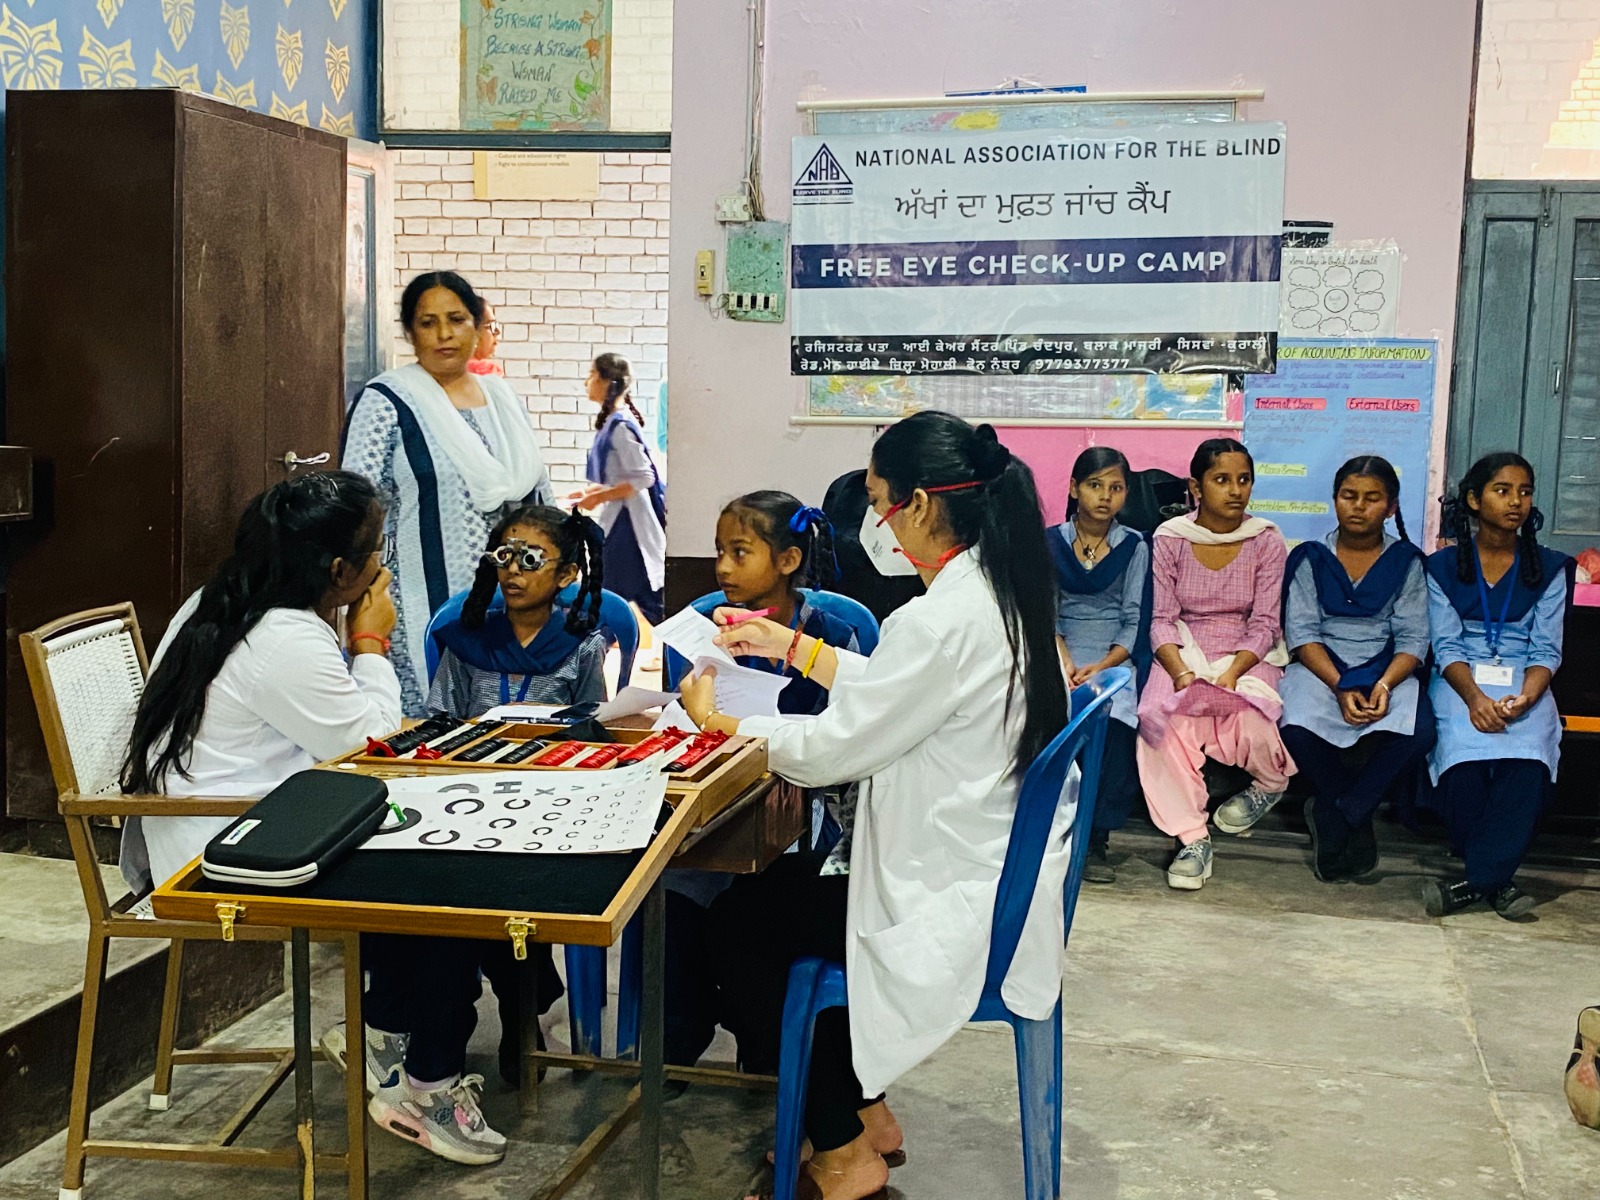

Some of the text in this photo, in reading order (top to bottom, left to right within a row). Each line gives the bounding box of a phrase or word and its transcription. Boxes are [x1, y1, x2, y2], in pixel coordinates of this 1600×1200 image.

[855, 137, 1282, 167] NATIONAL ASSOCIATION FOR THE BLIND
[808, 150, 841, 181] NAB
[895, 187, 948, 219] ਅੱਖਾਂ
[956, 195, 987, 218] ਦਾ
[1064, 184, 1118, 216] ਜਾਂਚ
[1127, 181, 1171, 214] ਕੈਂਪ
[819, 251, 1228, 278] FREE EYE CHECK-UP CAMP
[868, 342, 889, 353] ਪਤਾ
[1283, 347, 1297, 358] OF
[1359, 346, 1426, 360] INFORMATION
[1034, 358, 1130, 371] 9779377377
[1349, 398, 1415, 412] External Users
